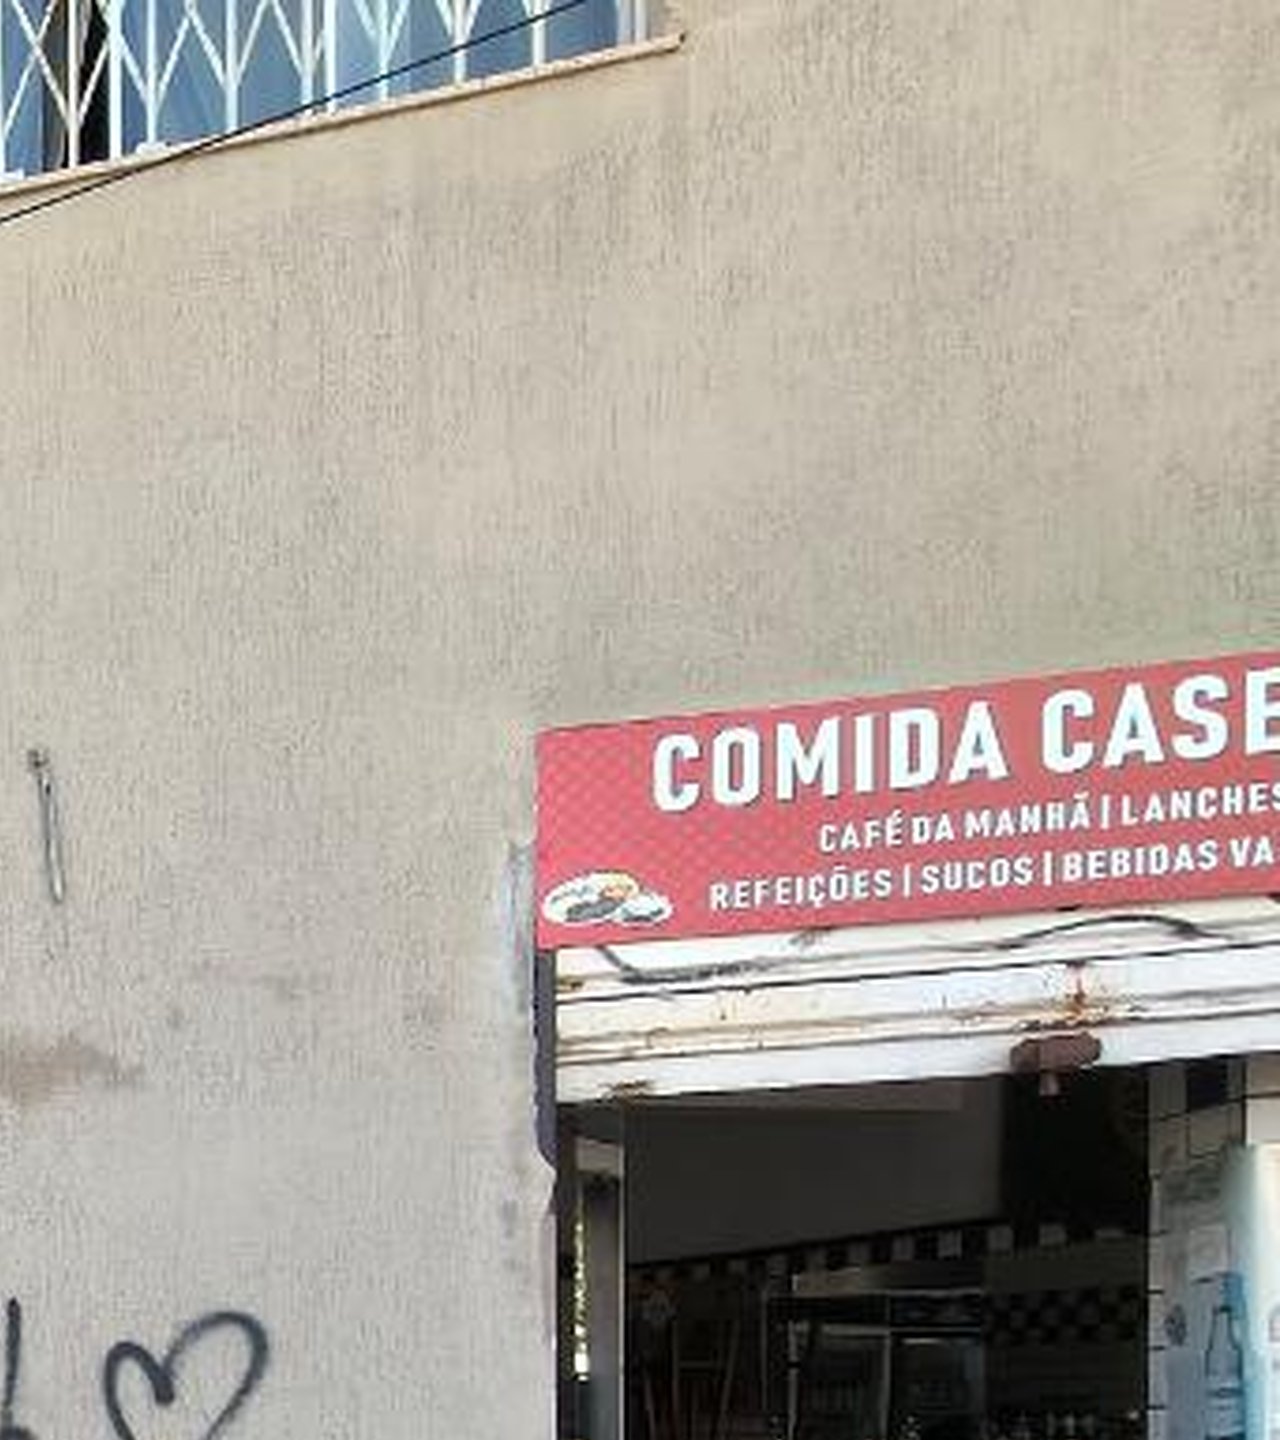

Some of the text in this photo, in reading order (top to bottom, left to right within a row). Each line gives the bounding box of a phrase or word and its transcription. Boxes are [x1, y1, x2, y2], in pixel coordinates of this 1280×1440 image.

[652, 666, 1280, 812] COMIDA CASE
[819, 809, 904, 853] CAFÉ
[911, 812, 956, 845] DA
[963, 791, 1090, 839] MANHÃ
[709, 836, 1275, 911] REFEIÇÕES SUCOS BEBIDAS VA
